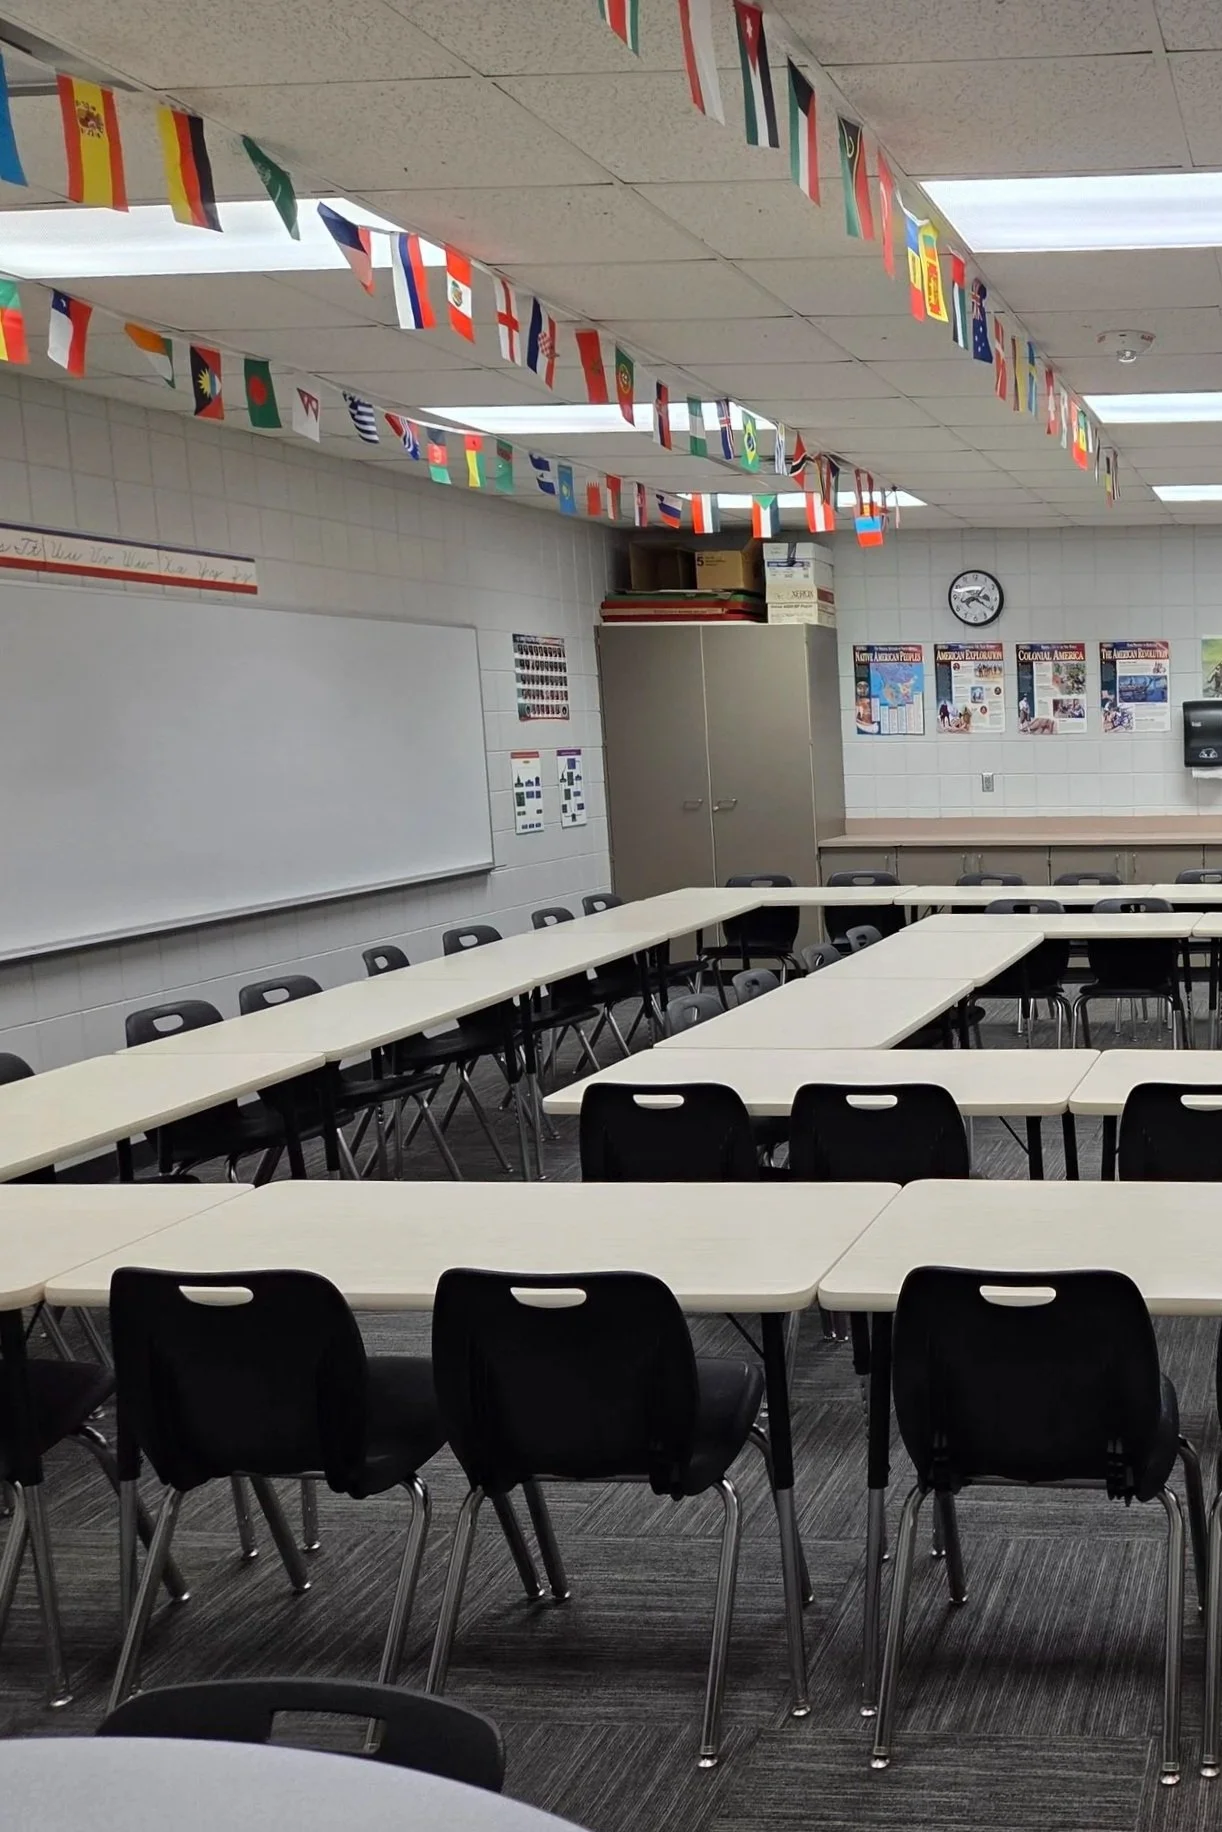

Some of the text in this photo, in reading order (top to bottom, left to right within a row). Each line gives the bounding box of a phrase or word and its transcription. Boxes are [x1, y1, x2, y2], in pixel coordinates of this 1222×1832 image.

[855, 651, 921, 662] NATIVE AMERICAN PEOPLES
[936, 650, 1003, 661] AMERICAN EXPLORATION
[1018, 649, 1085, 660] COLONIAL AMERICA
[1101, 648, 1169, 660] THE AMERICAN REVOLUTION
